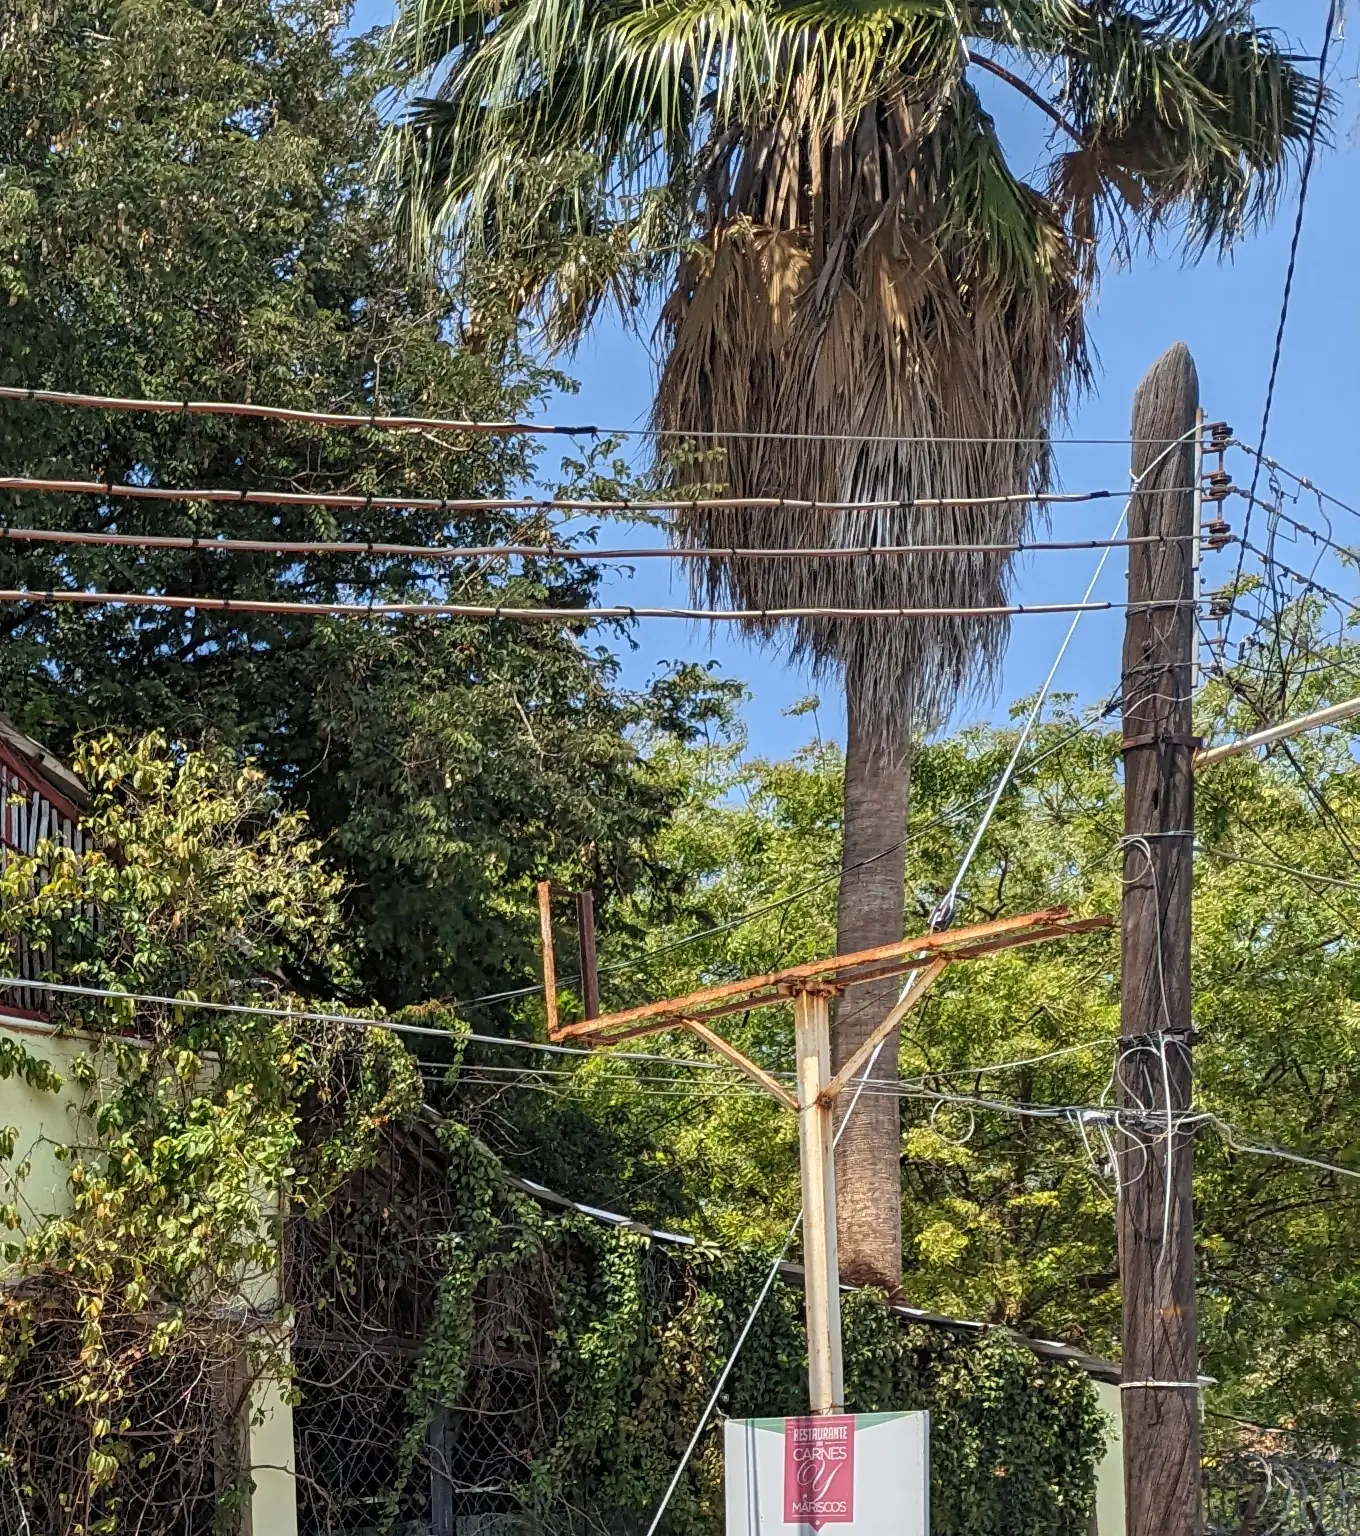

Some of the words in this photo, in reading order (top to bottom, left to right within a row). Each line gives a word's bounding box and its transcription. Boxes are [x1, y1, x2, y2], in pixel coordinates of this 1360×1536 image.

[793, 1426, 847, 1441] RESTAURANTE
[793, 1447, 847, 1461] CARNES
[792, 1501, 847, 1514] MARISCOS
